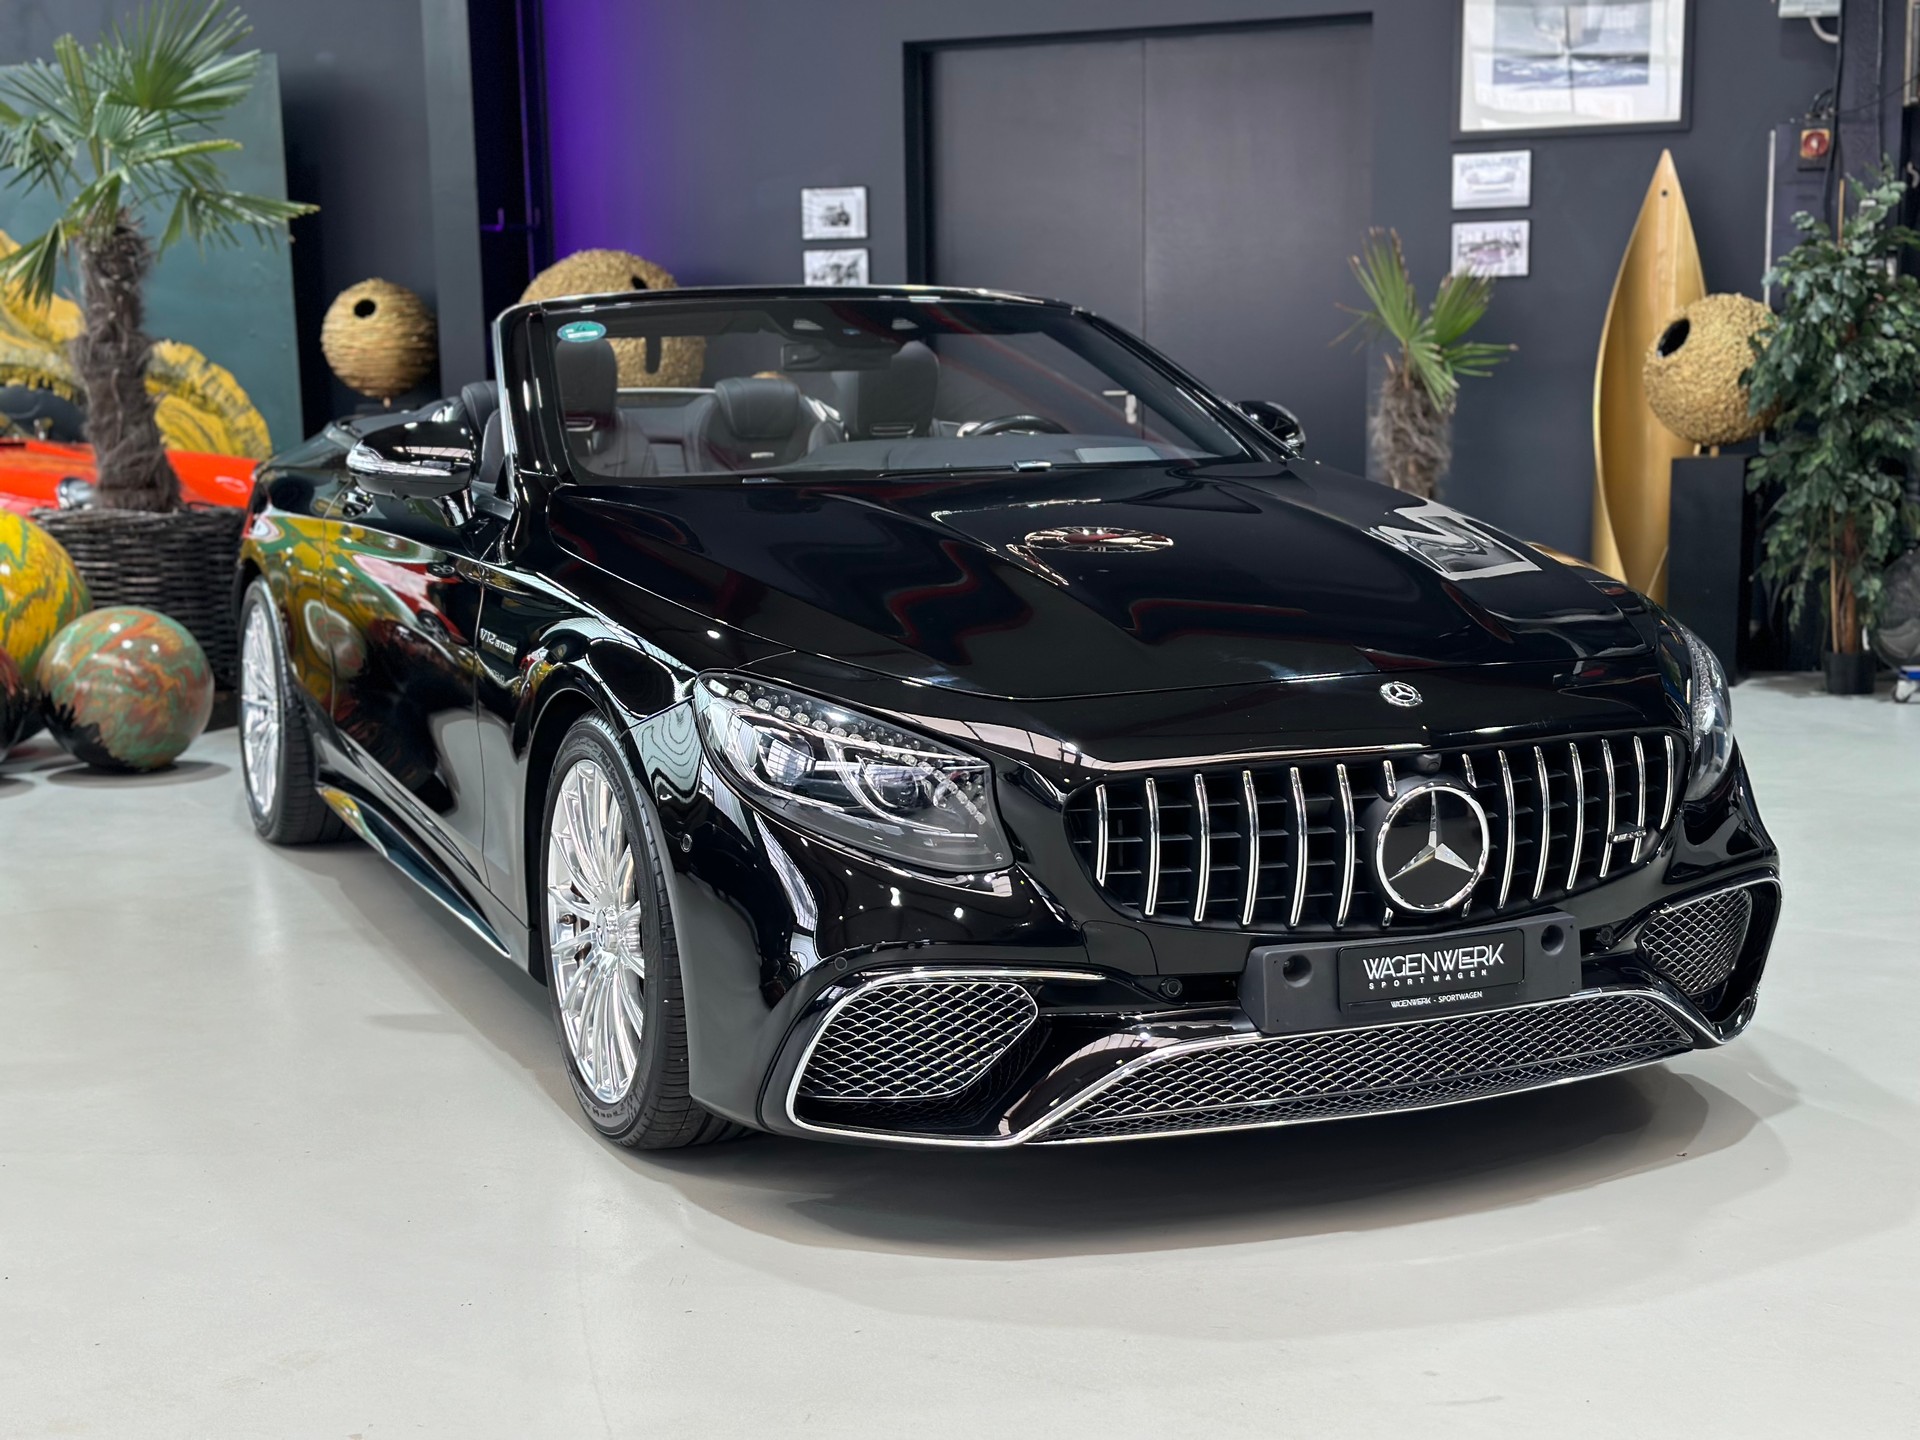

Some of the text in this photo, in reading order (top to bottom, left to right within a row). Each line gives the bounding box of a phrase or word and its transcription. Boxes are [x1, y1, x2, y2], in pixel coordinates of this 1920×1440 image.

[1362, 943, 1505, 980] WAGENWERK
[1368, 969, 1487, 990] SPORTWAGEN
[1390, 996, 1431, 1009] WAGENWERK
[1438, 990, 1483, 1003] SPORTWAGEN
